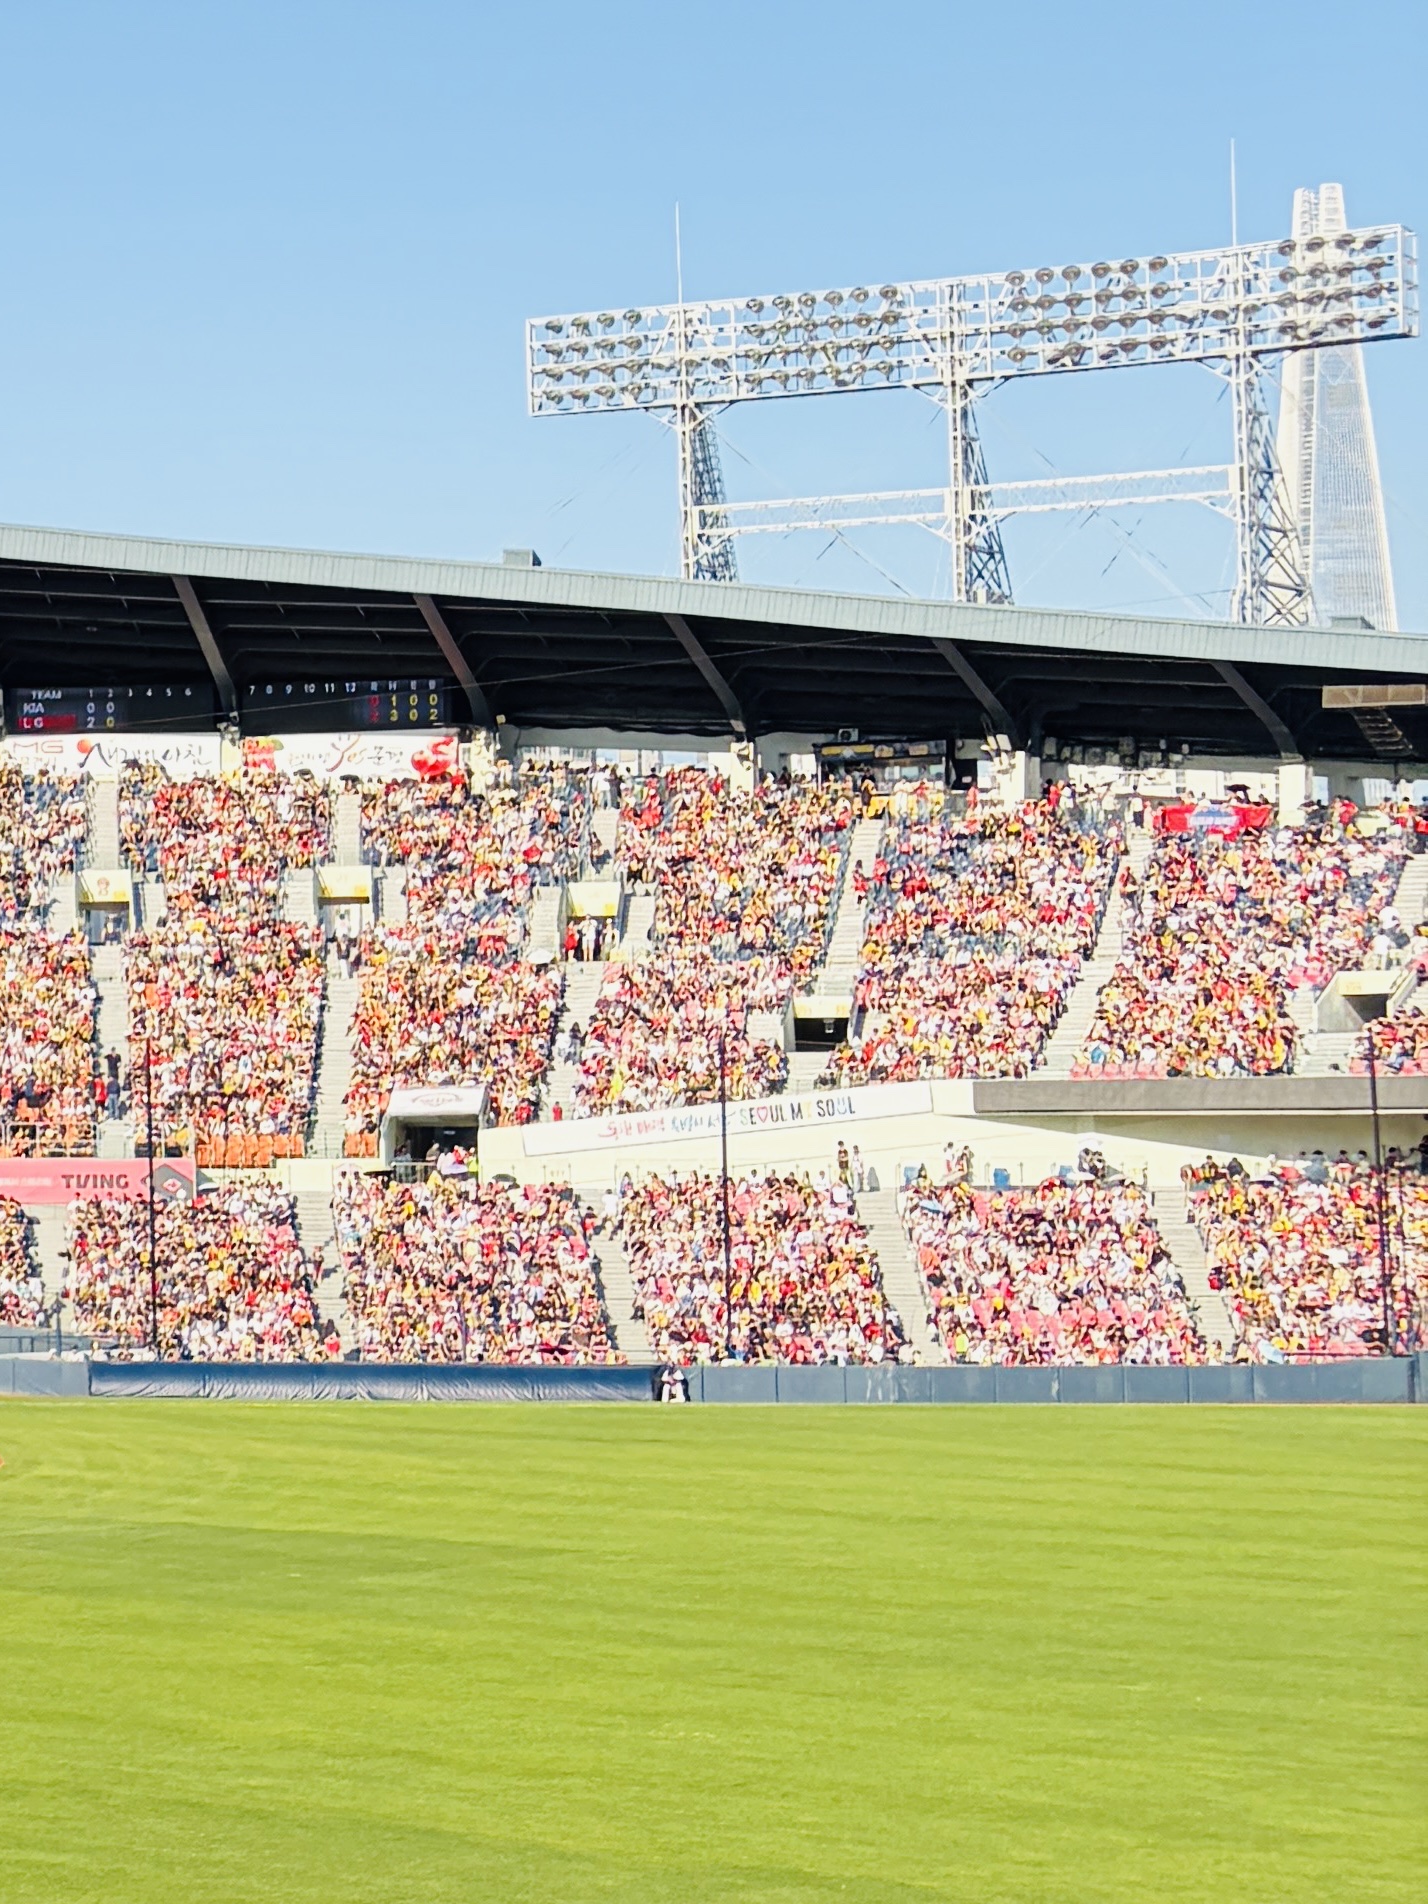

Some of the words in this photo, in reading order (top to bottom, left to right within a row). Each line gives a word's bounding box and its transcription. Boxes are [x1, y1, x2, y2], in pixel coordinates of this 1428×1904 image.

[304, 683, 316, 694] 10
[324, 683, 335, 693] 11
[32, 690, 62, 700] TEAM
[409, 694, 418, 706] 0
[429, 693, 438, 705] 0
[23, 702, 45, 714] KIA
[87, 702, 95, 714] 0
[106, 702, 115, 713] 0
[409, 709, 418, 721] 0
[429, 709, 438, 720] 2
[87, 717, 95, 729] 2
[106, 717, 115, 728] 0
[61, 1173, 130, 1190] TVING
